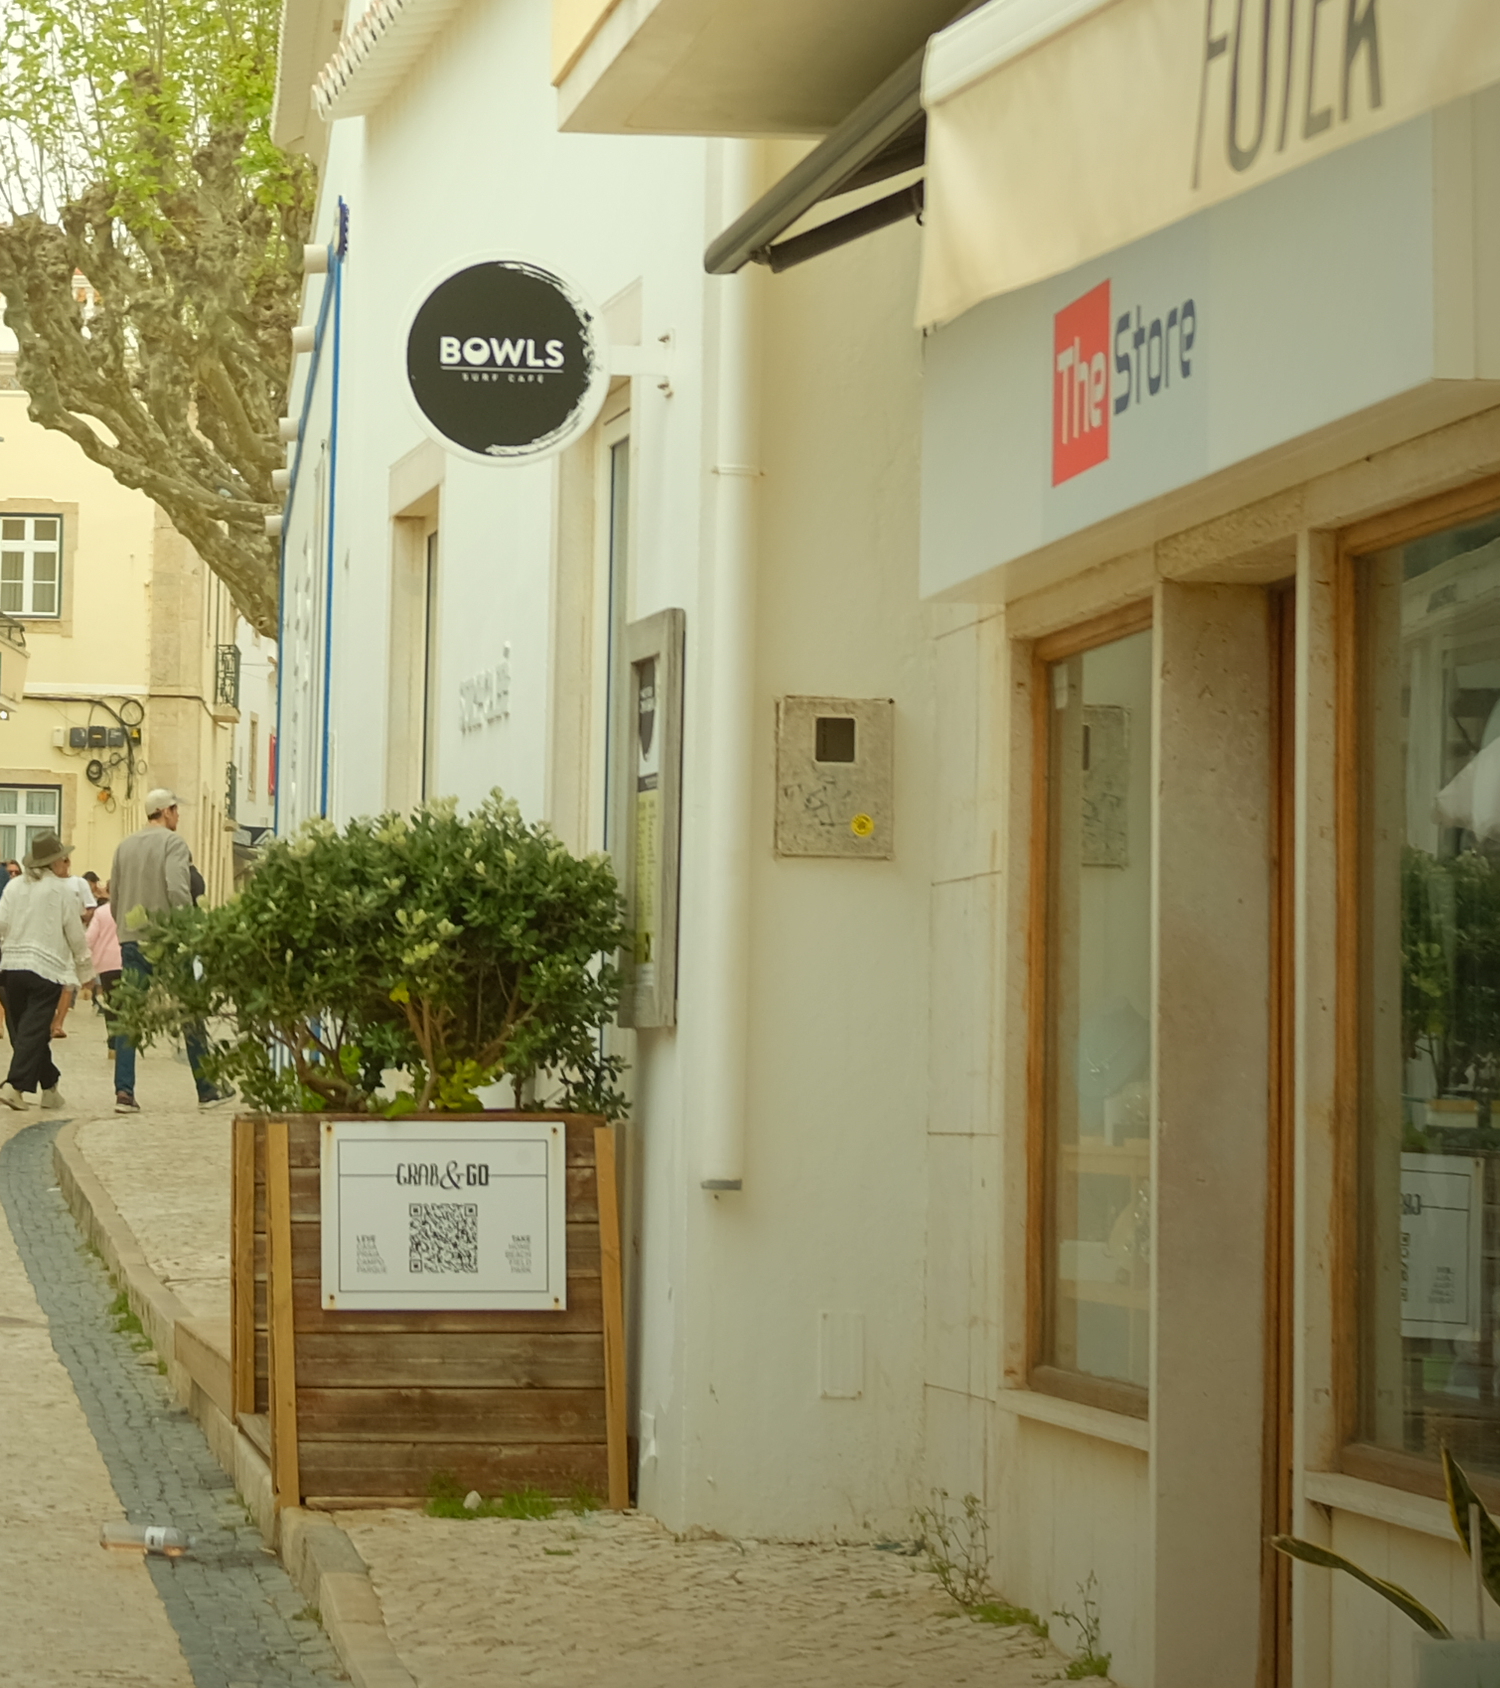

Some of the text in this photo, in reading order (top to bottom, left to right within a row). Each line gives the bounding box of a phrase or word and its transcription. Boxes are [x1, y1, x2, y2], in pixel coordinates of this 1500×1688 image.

[440, 336, 564, 367] BOWLS
[1056, 298, 1196, 446] The Store
